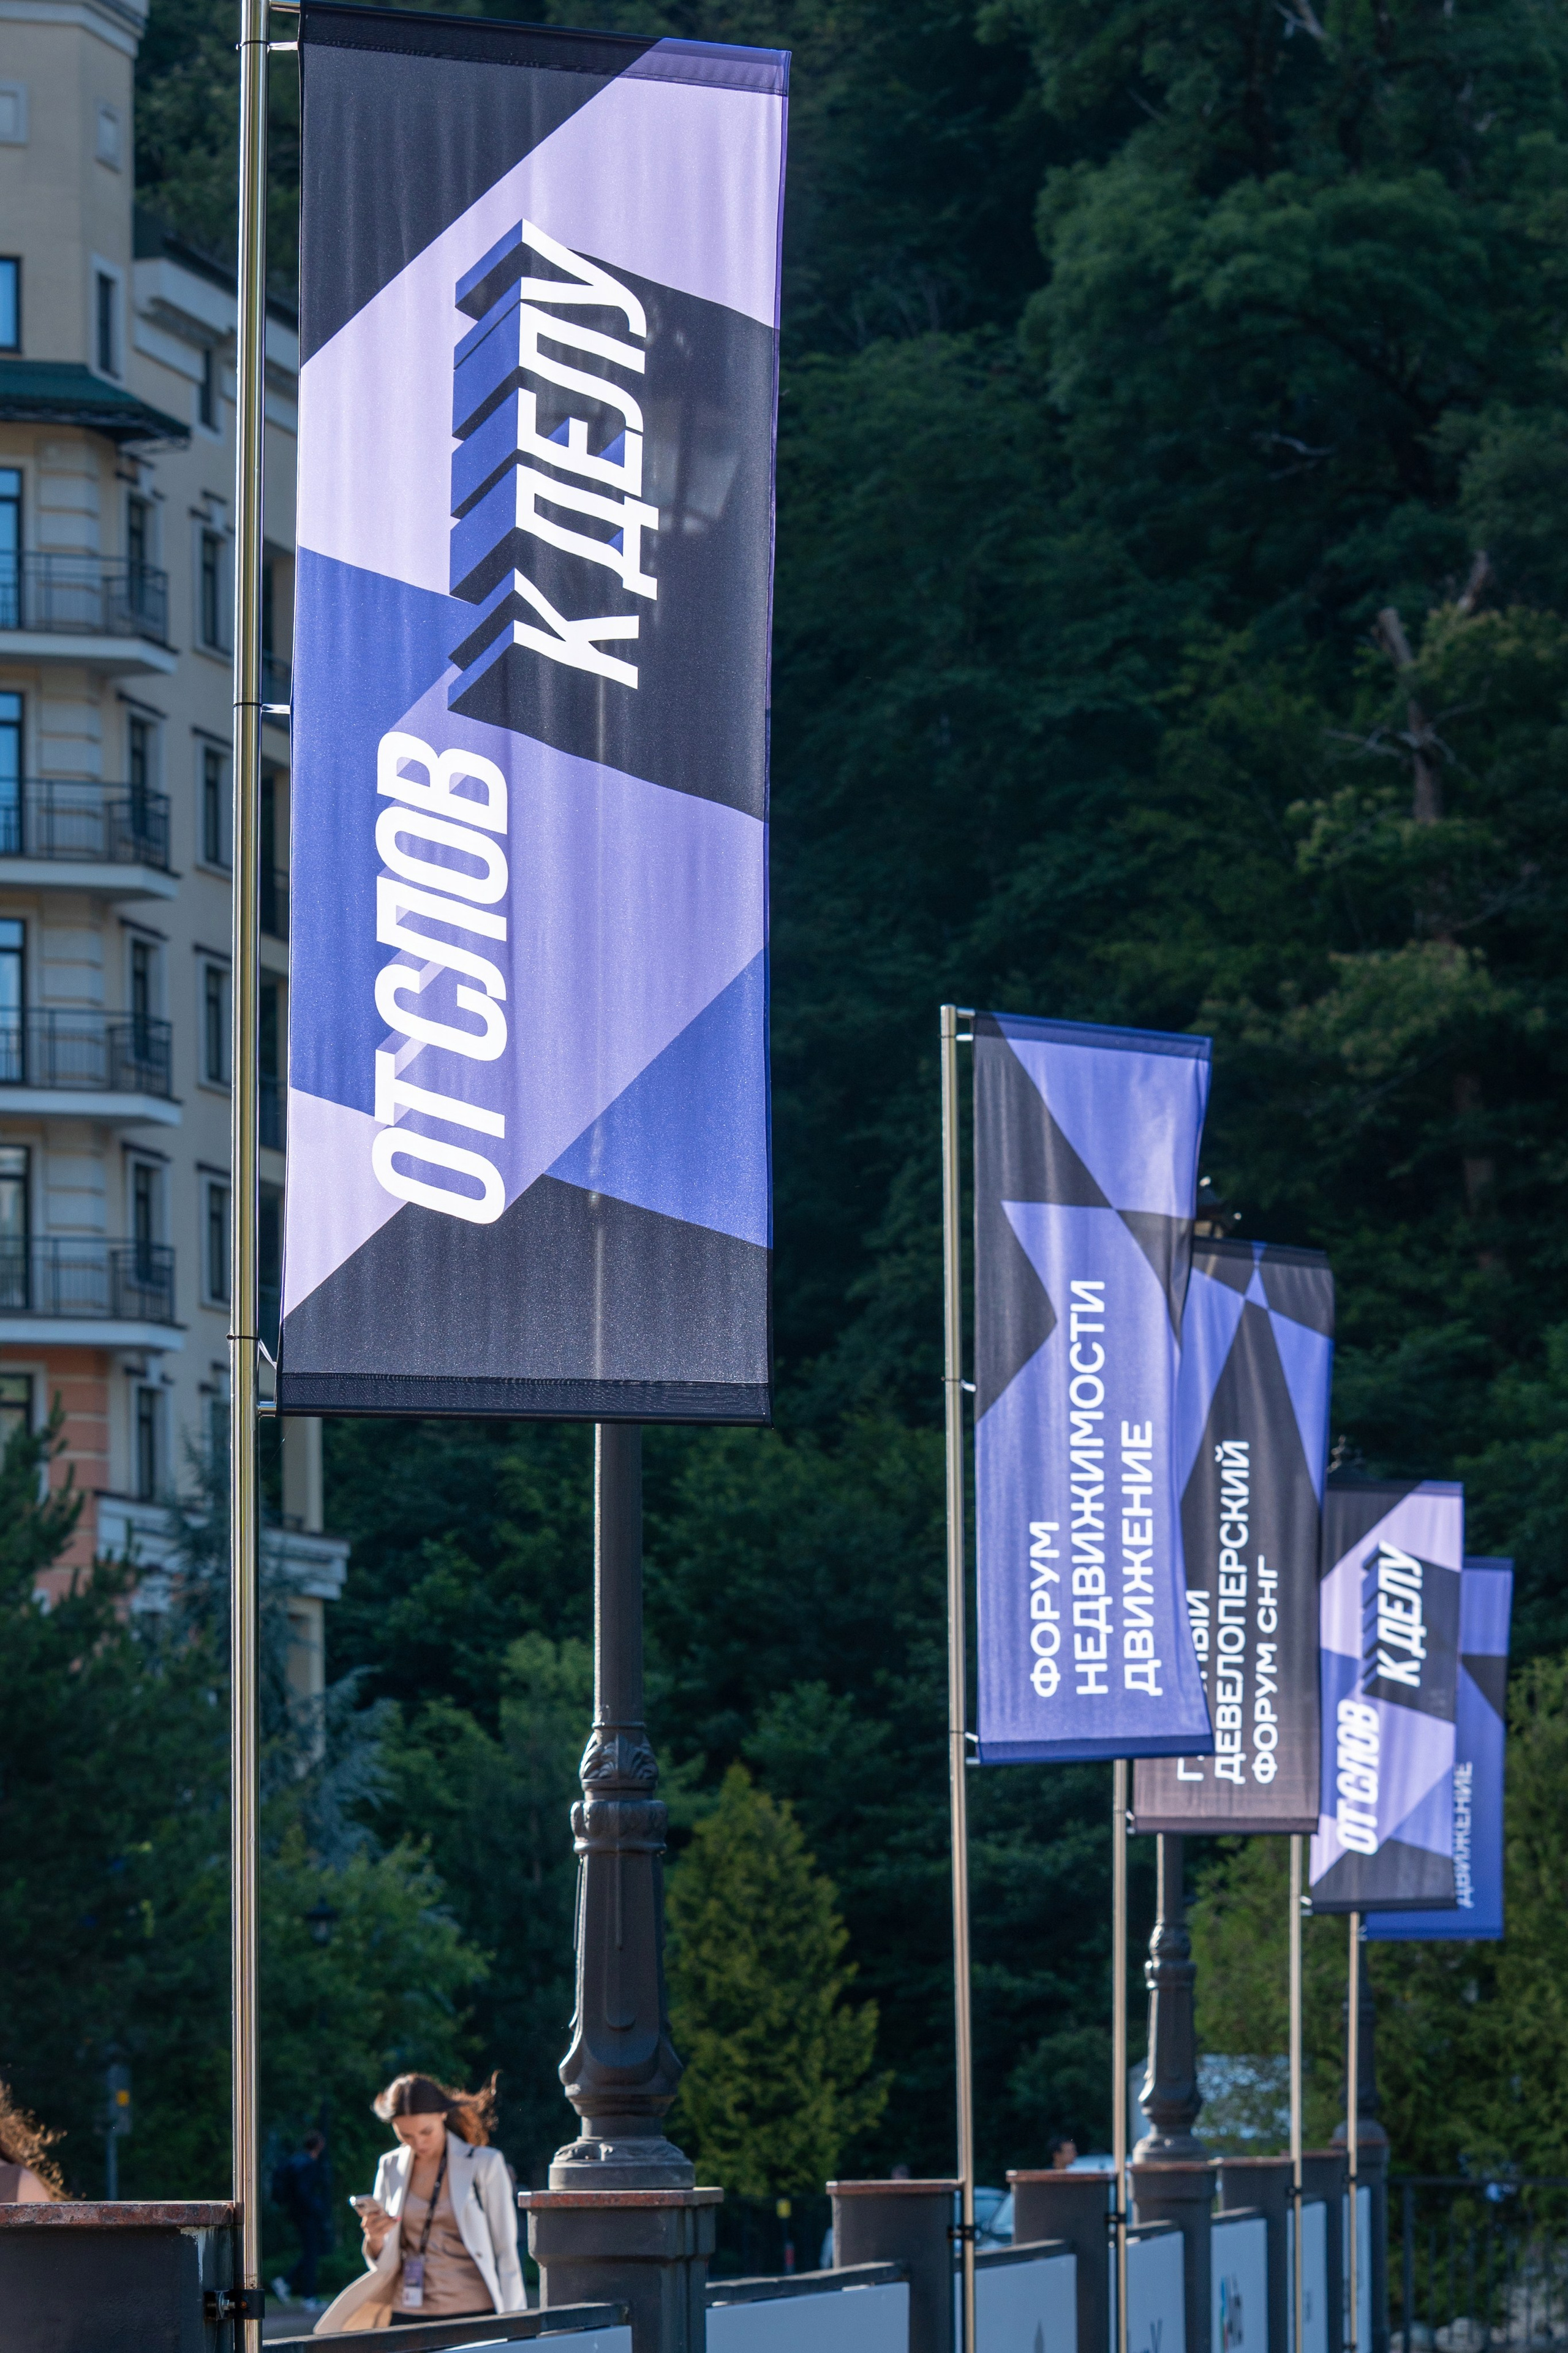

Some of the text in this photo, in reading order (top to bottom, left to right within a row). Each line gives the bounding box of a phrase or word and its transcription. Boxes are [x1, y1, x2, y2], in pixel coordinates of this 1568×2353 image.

[514, 218, 658, 689] К ДЕЛУ
[372, 731, 508, 1225] ОТ СЛОВ
[1030, 1522, 1060, 1697] ФОРУМ
[1069, 1280, 1113, 1695] НЕДВИЖИМОСТИ
[1121, 1420, 1163, 1696] ДВИЖЕНИЕ
[1215, 1440, 1250, 1785] ДЕВЕЛОПЕРСКИЙ
[1377, 1540, 1427, 1687] К ДЕЛУ
[1252, 1554, 1278, 1785] ФОРУМ СНГ
[1336, 1699, 1379, 1855] ОТ СЛОВ
